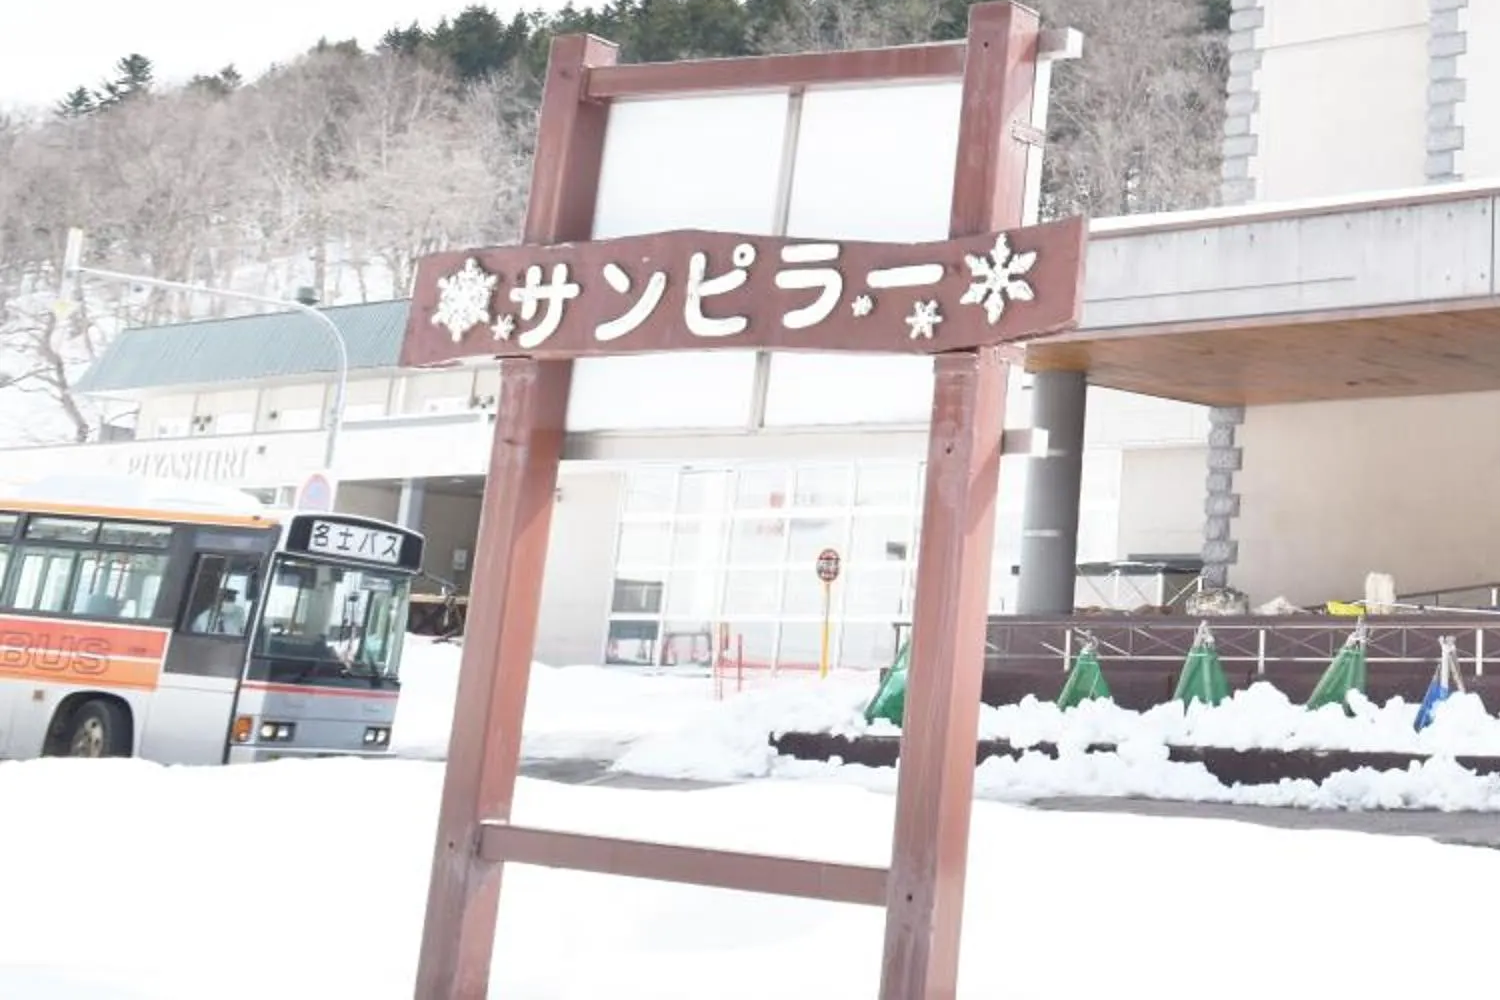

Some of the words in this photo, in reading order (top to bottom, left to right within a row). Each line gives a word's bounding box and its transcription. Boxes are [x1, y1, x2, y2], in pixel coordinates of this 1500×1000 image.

[509, 242, 945, 348] サンピラー
[313, 523, 398, 558] 名士バス
[0, 630, 111, 676] BUS
